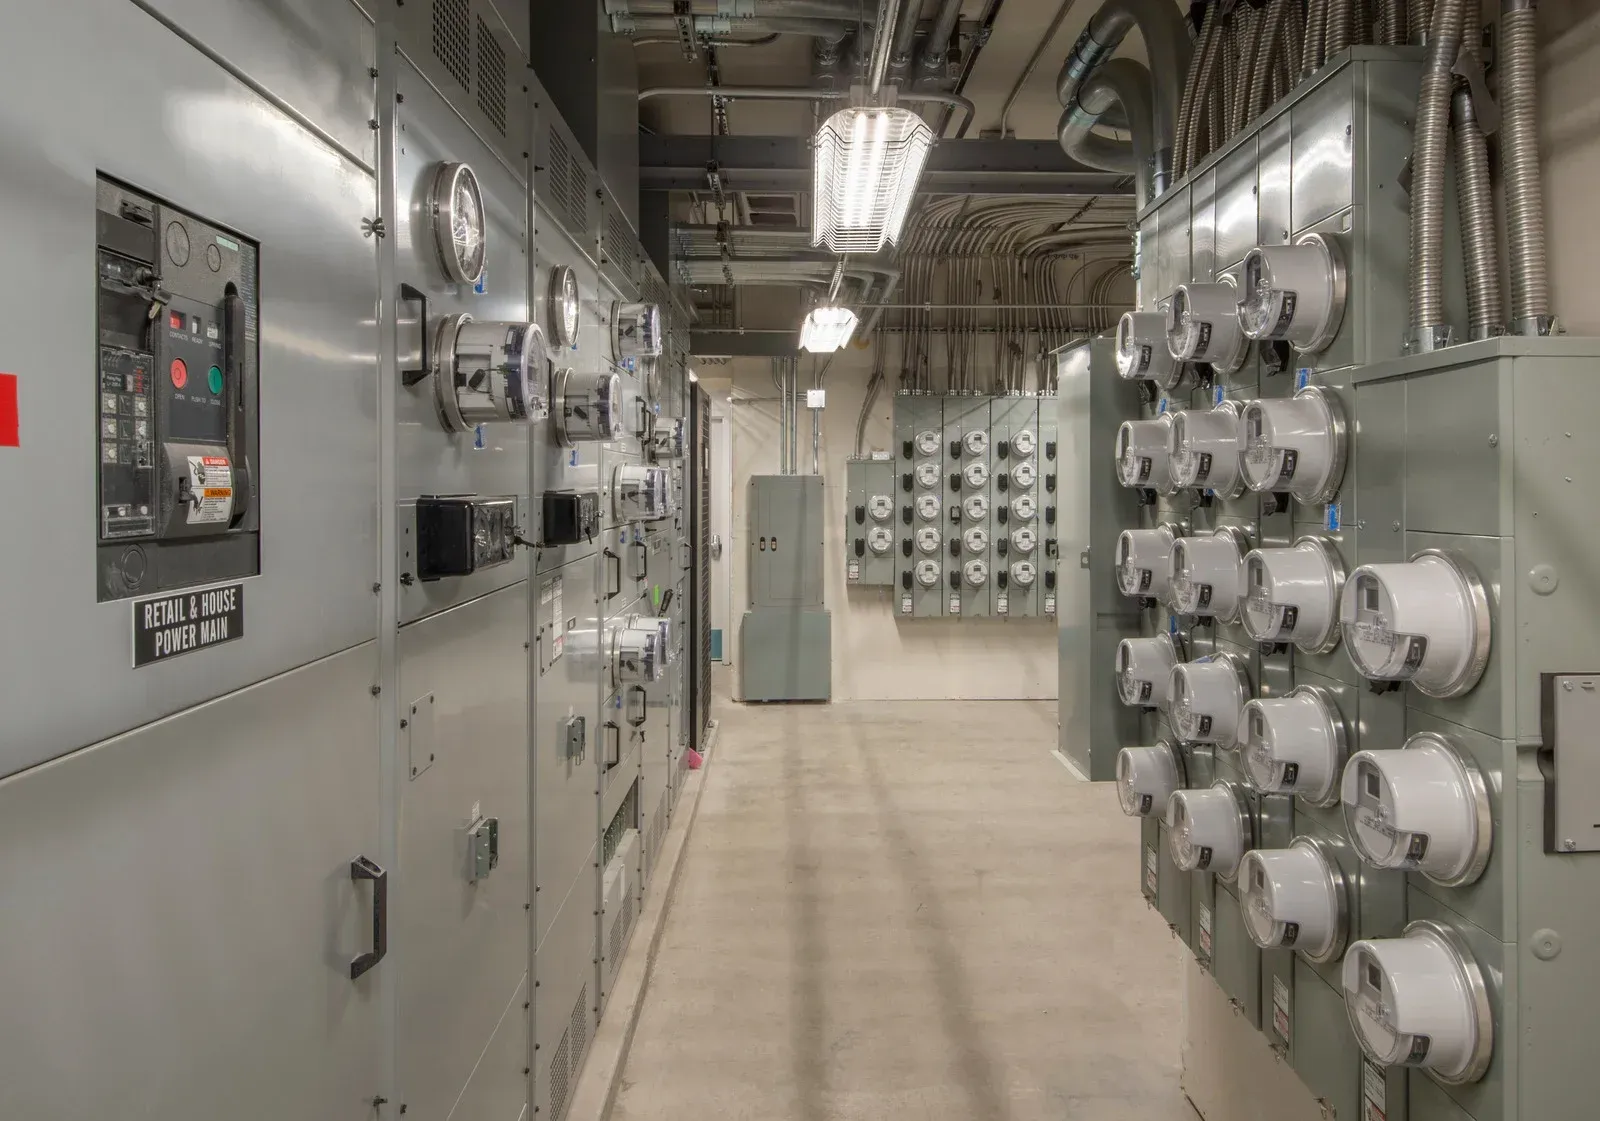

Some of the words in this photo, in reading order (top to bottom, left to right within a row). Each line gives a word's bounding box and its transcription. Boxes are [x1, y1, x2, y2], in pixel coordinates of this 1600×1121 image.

[144, 597, 186, 629] RETAIL
[190, 595, 198, 620] &
[202, 588, 236, 617] HOUSE
[155, 624, 196, 657] POWER
[200, 616, 228, 645] MAIN
